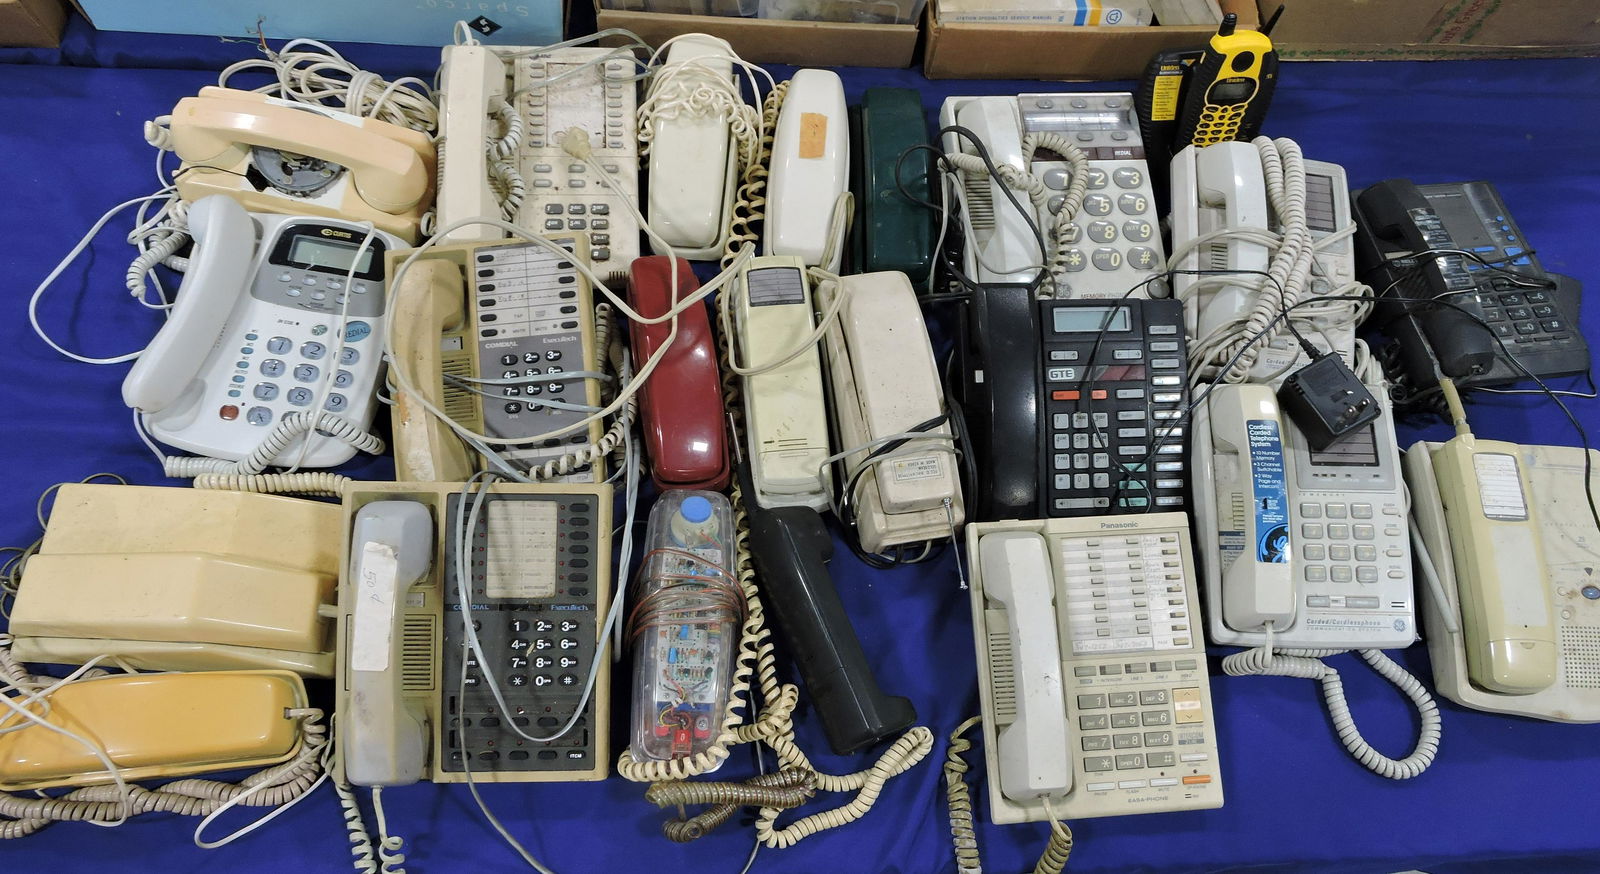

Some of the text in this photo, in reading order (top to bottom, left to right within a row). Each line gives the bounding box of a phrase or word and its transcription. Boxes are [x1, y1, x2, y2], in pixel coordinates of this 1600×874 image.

[1095, 172, 1105, 185] 2
[1130, 171, 1139, 185] 3
[1100, 198, 1110, 211] 5
[1135, 198, 1145, 211] 6
[1104, 225, 1114, 239] 8
[1140, 223, 1150, 237] 9
[1110, 252, 1120, 266] 0
[1140, 251, 1151, 264] #
[278, 341, 284, 351] 1
[310, 345, 321, 355] 2
[343, 351, 353, 359] 3
[504, 355, 510, 364] 1
[268, 362, 278, 372] 4
[303, 367, 314, 376] 5
[1050, 369, 1073, 379] GTE
[336, 375, 346, 384] 6
[264, 386, 275, 396] 7
[295, 391, 306, 402] 8
[331, 397, 342, 407] 9
[1100, 521, 1138, 529] Panasonic
[1127, 694, 1134, 704] 2
[1158, 691, 1165, 701] 3
[1098, 716, 1105, 726] 4
[1129, 714, 1136, 725] 5
[1159, 712, 1167, 722] 6
[1101, 737, 1108, 747] 7
[1131, 735, 1138, 746] 8
[1162, 733, 1169, 743] 9
[1134, 756, 1141, 766] 0
